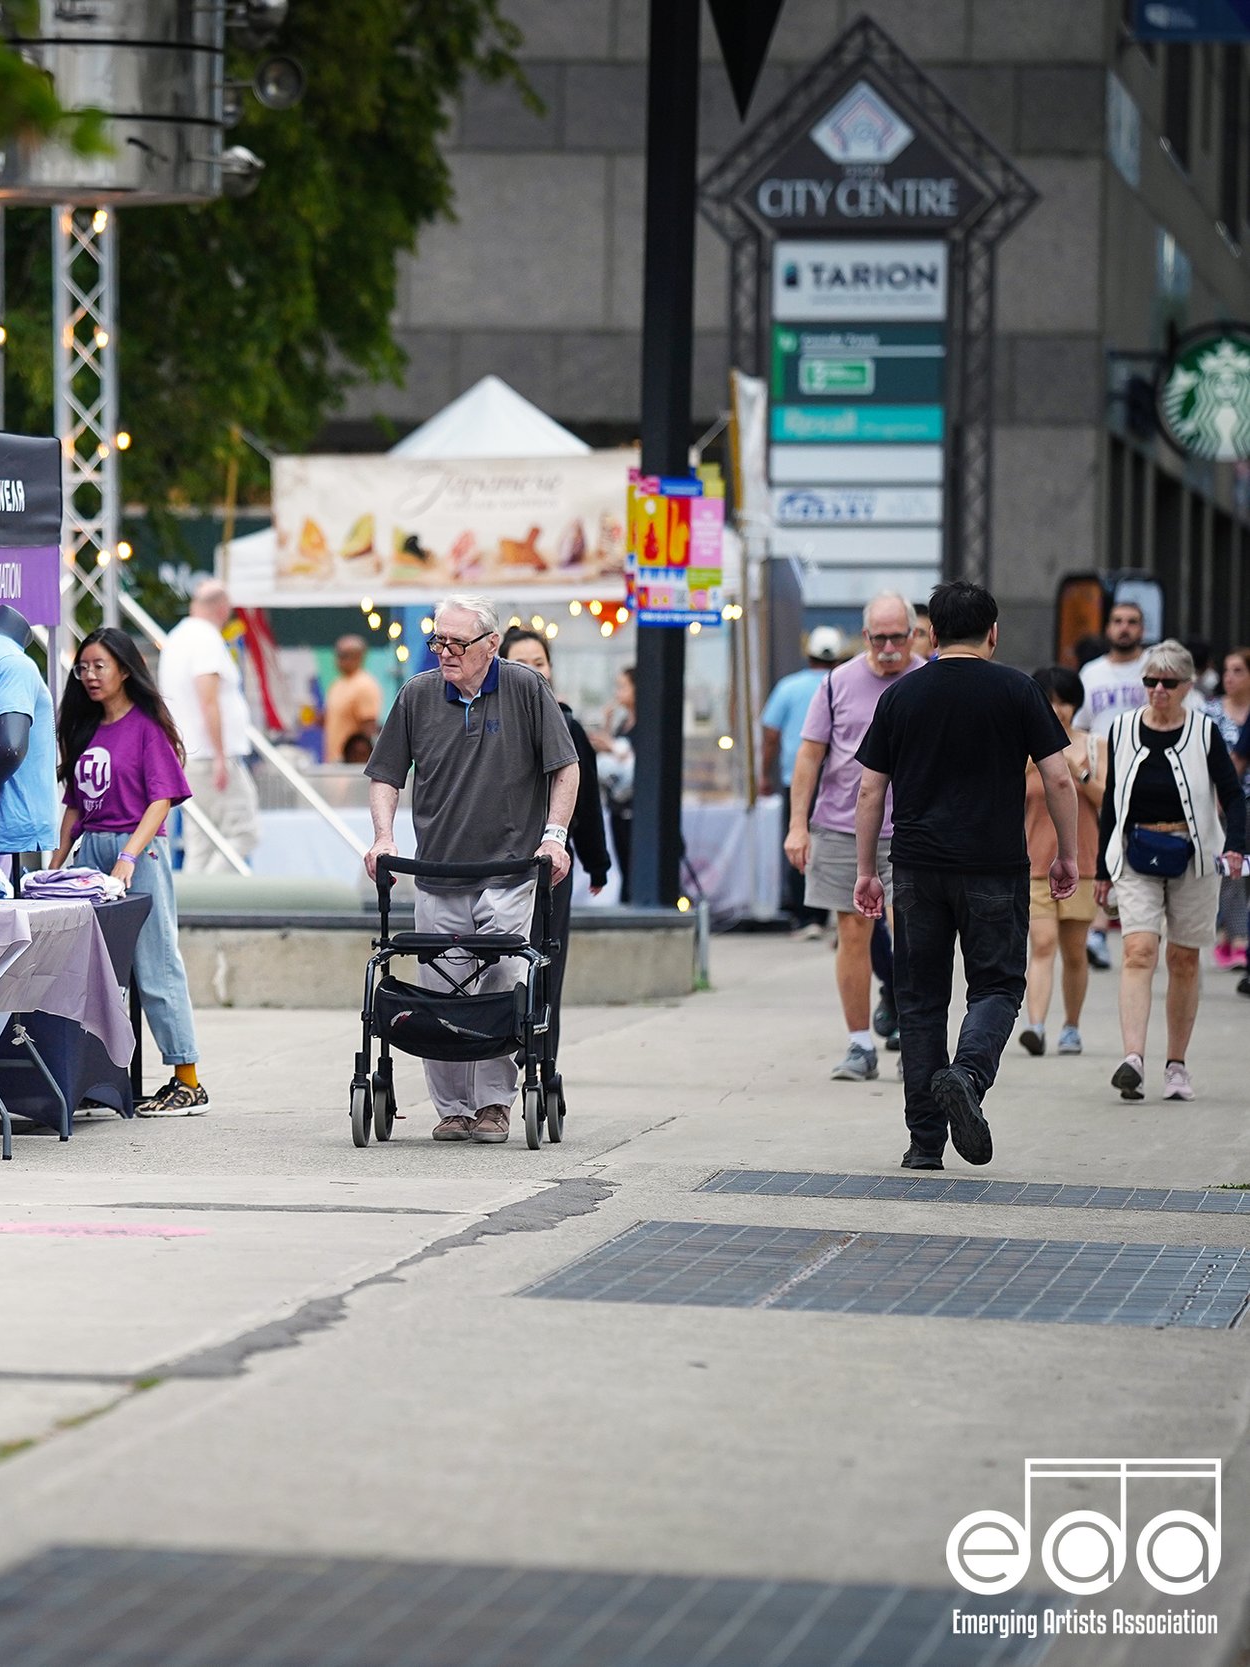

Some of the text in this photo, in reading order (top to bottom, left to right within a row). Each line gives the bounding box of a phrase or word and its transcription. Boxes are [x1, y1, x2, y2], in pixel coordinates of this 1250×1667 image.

[758, 178, 958, 218] CITY CENTRE
[810, 261, 938, 290] TARION
